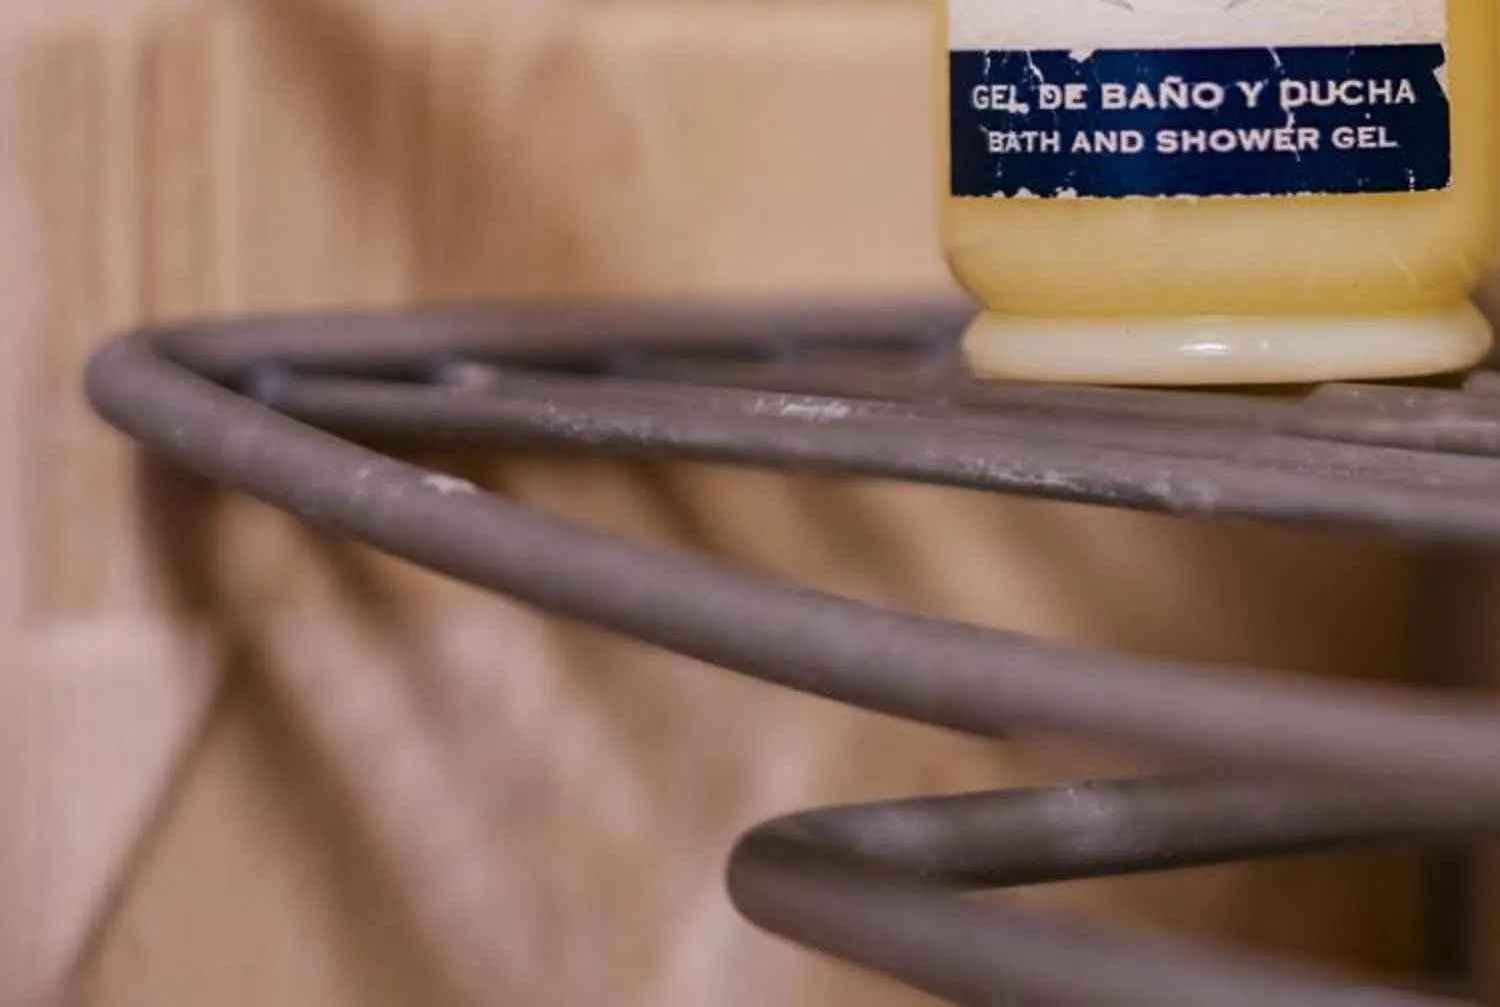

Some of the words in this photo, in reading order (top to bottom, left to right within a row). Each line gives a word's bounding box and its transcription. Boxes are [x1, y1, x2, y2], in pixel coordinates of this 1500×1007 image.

[972, 83, 1023, 111] GEL
[1039, 83, 1088, 110] DE
[1101, 76, 1224, 110] BAÑO
[1236, 81, 1264, 108] Y
[1280, 79, 1416, 108] DUCHA
[988, 130, 1061, 153] BATH
[1071, 130, 1144, 153] AND
[1156, 126, 1320, 153] SHOWER
[1331, 126, 1398, 149] GEL
